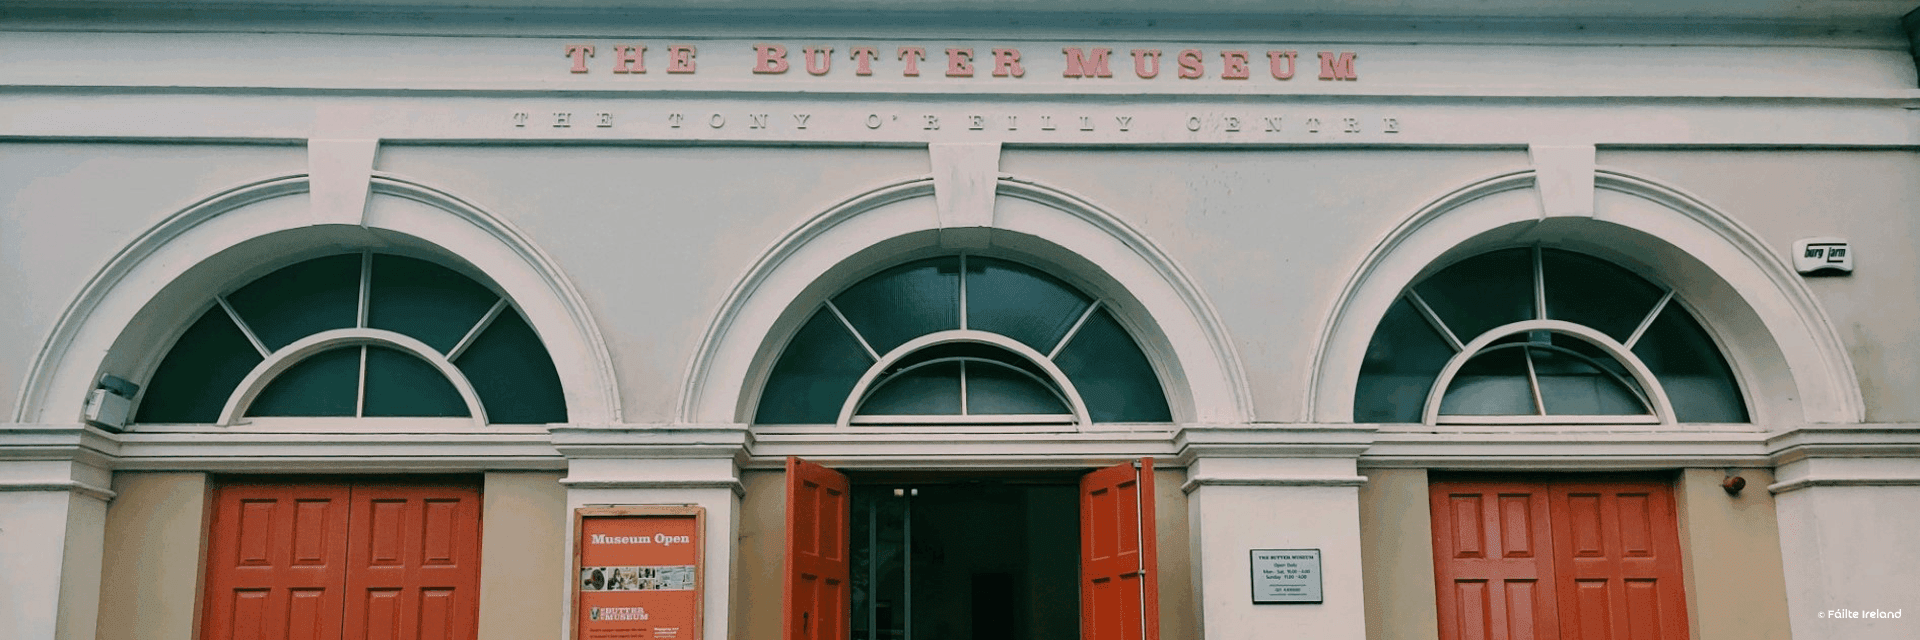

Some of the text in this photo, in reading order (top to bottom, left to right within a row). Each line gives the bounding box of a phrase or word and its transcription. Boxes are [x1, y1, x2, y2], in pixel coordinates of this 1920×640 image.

[565, 43, 1358, 82] THE BUTTER MUSEUM
[513, 111, 1401, 134] THE TONY O'REILLY CENTRE
[591, 533, 690, 546] Museum Open
